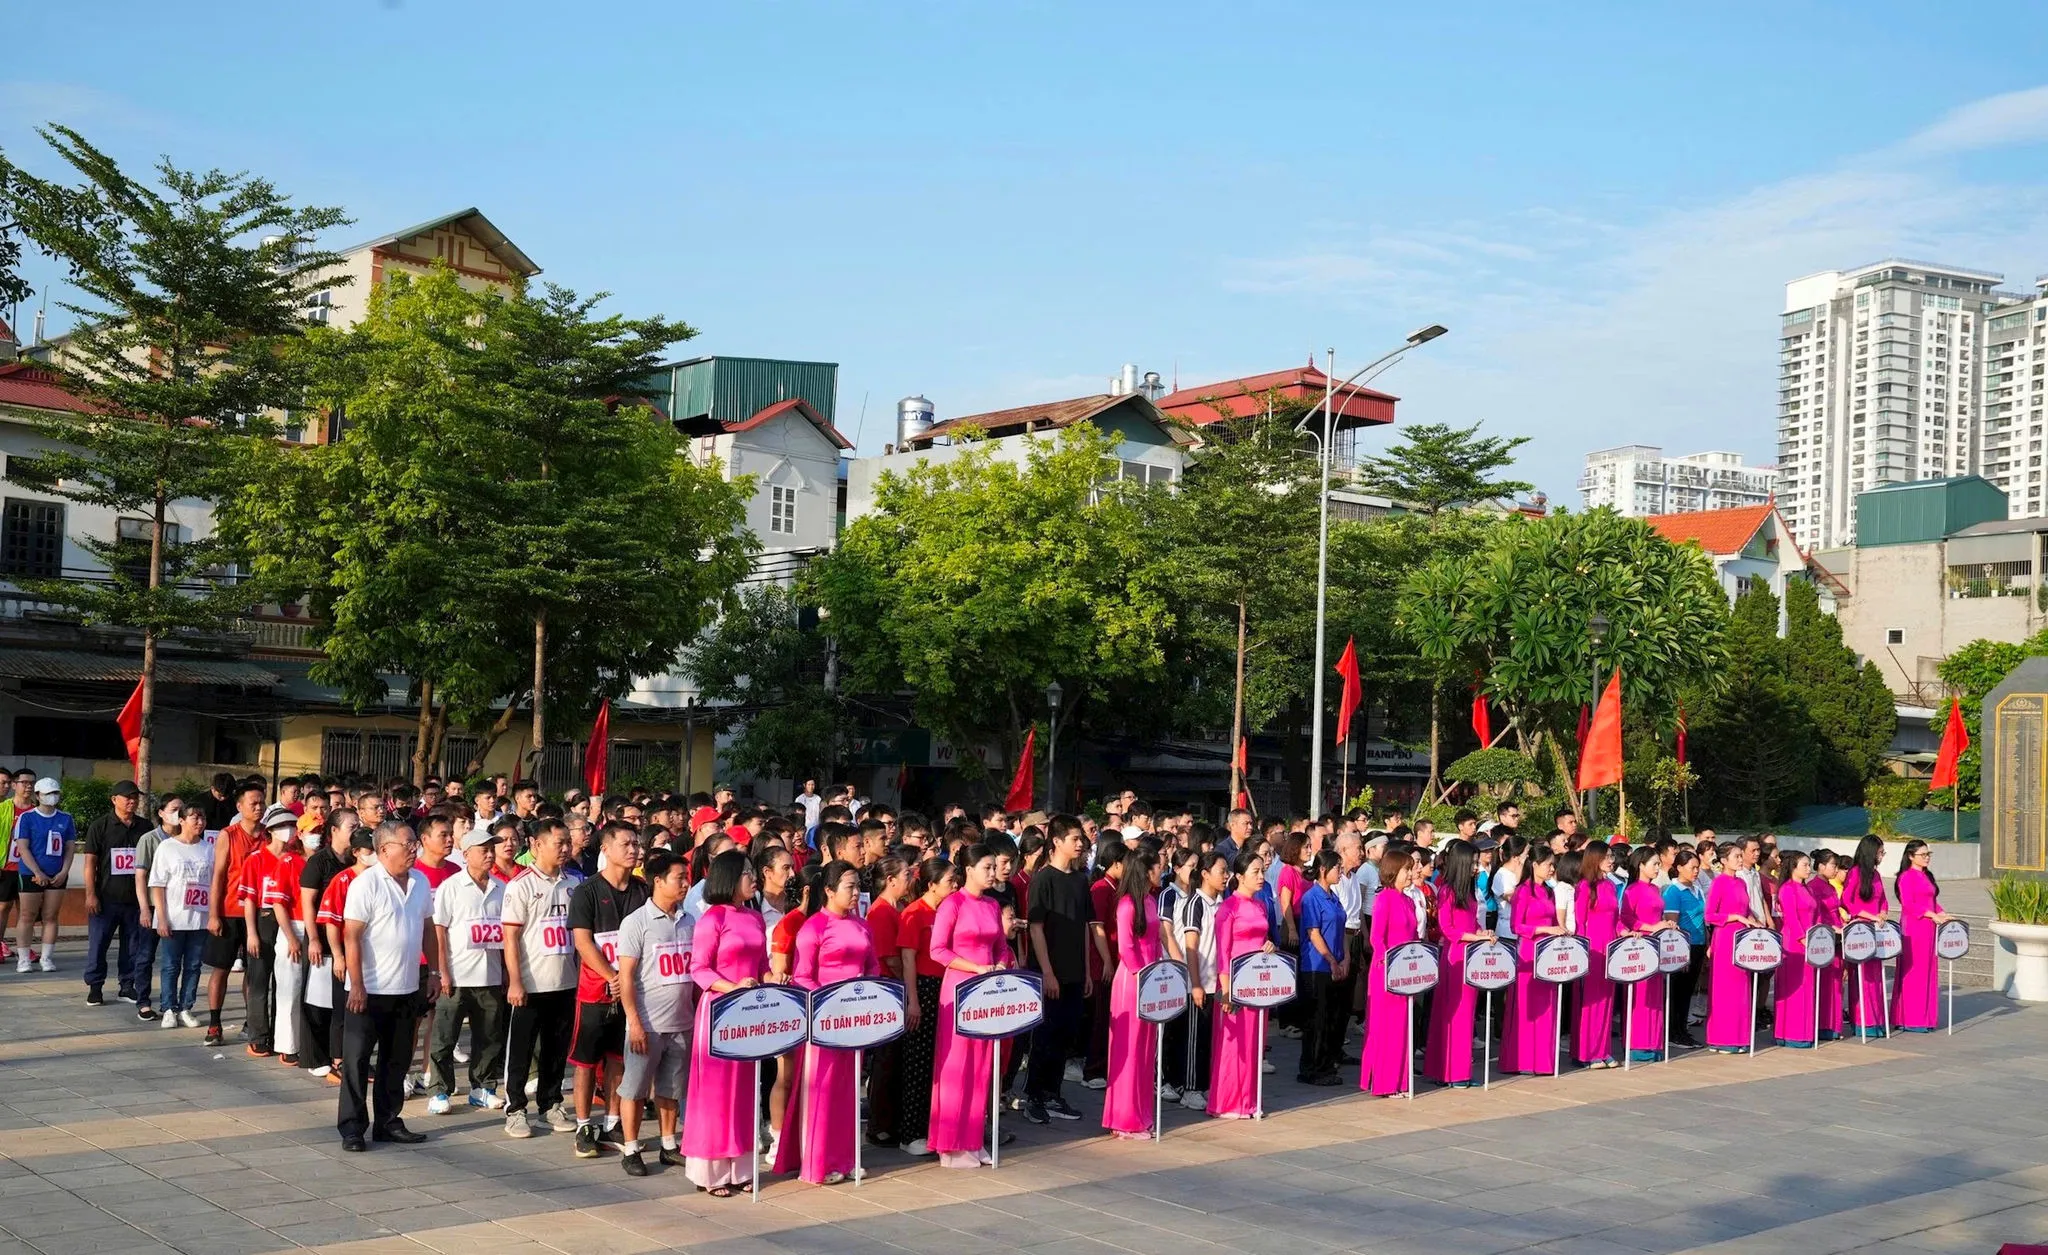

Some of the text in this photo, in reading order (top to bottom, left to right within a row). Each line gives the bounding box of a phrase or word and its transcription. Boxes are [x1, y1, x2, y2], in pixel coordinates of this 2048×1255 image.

[116, 855, 136, 869] 02
[186, 890, 208, 906] 028
[472, 924, 503, 943] 023
[602, 942, 618, 964] 0
[1628, 952, 1639, 961] KHỐI
[660, 952, 692, 976] 002
[1257, 988, 1268, 996] THCS
[1281, 986, 1291, 995] NAM
[820, 1011, 897, 1031] TỔ DÂN PHỐ 23-34
[962, 1002, 1038, 1022] TỔ DÂN PHỐ 20-21-22
[719, 1019, 800, 1042] TỔ DÂN PHỐ 25-26-27
